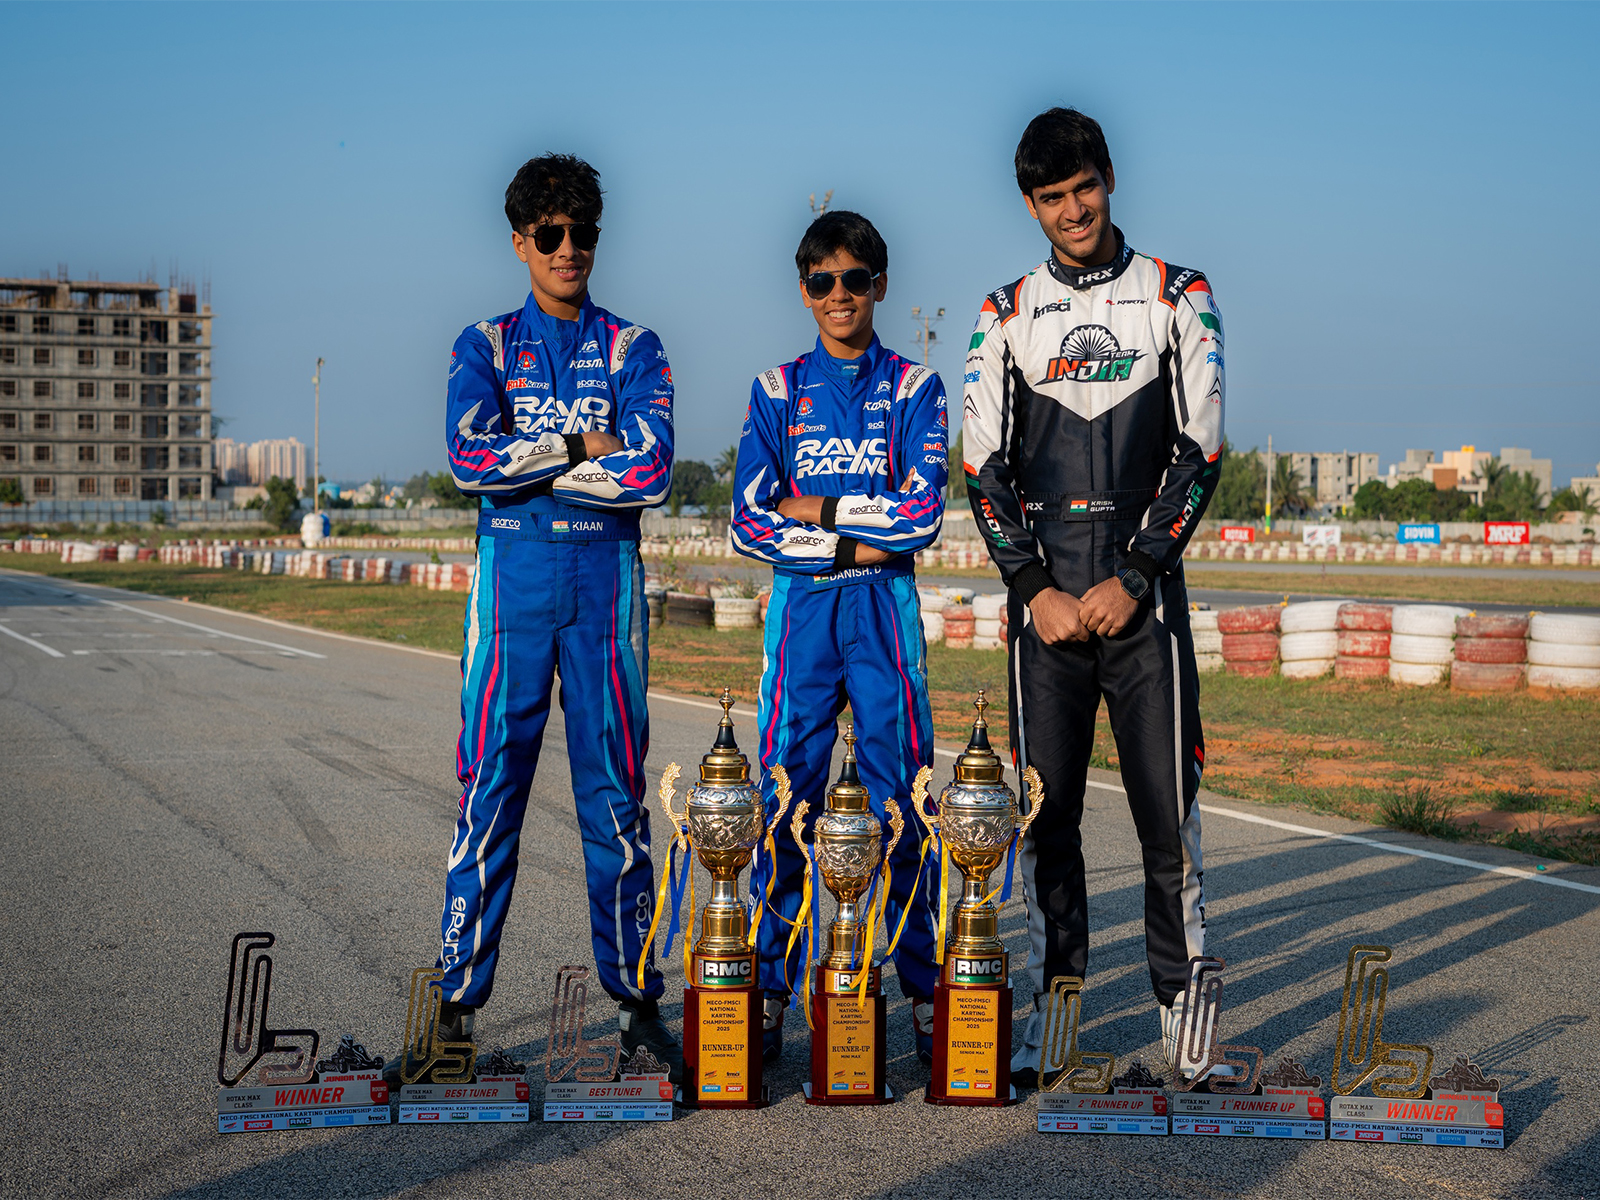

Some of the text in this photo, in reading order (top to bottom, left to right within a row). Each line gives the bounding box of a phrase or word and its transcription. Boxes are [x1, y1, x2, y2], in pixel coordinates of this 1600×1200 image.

[1078, 267, 1114, 285] HRX
[1168, 270, 1194, 295] HRX
[995, 288, 1012, 310] HRX
[1033, 299, 1071, 319] fmsci
[1047, 358, 1135, 381] INDIA
[514, 396, 610, 417] RAVO
[512, 415, 609, 434] RACING
[572, 472, 609, 483] sparco
[848, 504, 882, 515] sparco
[491, 518, 520, 530] sparco
[572, 521, 603, 531] KIAAN
[1488, 525, 1526, 542] MRF
[874, 565, 882, 574] D
[705, 962, 751, 976] RMC
[957, 960, 1002, 974] RMC
[702, 1044, 745, 1052] RUNNER-UP
[952, 1041, 994, 1049] RUNNER-UP
[275, 1087, 344, 1106] WINNER
[444, 1089, 498, 1098] BEST TUNER
[589, 1088, 642, 1096] BEST TUNER
[1091, 1100, 1129, 1109] RUNNER
[1131, 1101, 1144, 1109] UP
[1233, 1101, 1278, 1112] RUNNER
[1281, 1103, 1295, 1112] UP
[1387, 1103, 1458, 1121] WINNER
